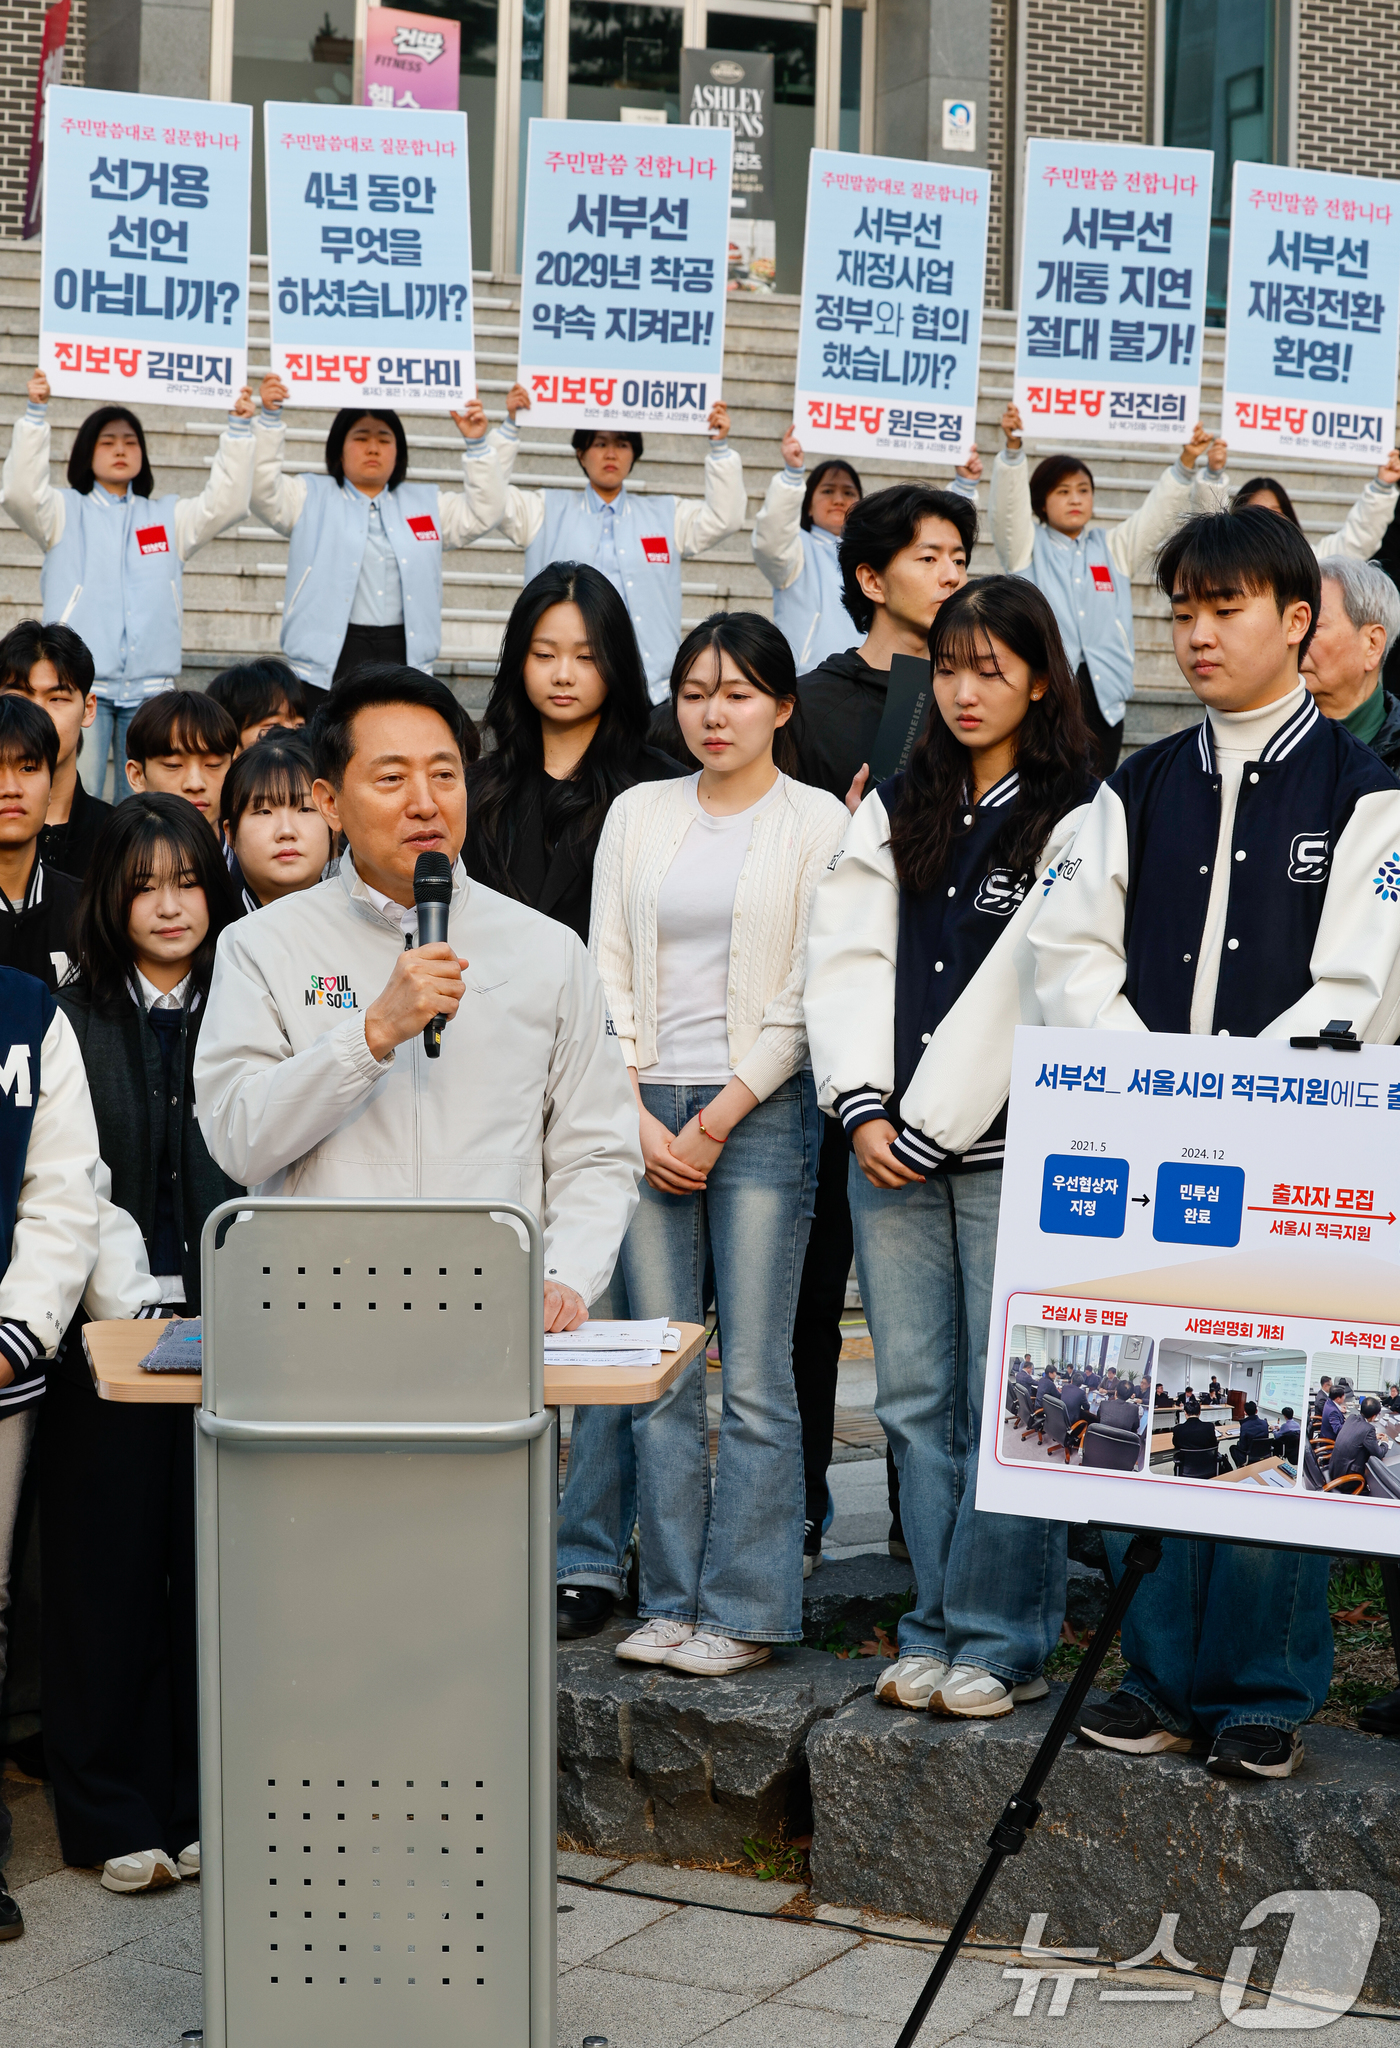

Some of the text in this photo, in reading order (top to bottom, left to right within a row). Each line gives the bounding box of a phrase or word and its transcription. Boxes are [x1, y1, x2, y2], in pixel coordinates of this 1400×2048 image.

[375, 54, 422, 72] FITNESS
[691, 84, 764, 112] ASHLEY
[61, 118, 240, 151] 주민말씀대로 질문합니다
[690, 109, 764, 138] QUEENS
[281, 134, 456, 157] 주민말씀대로 질문합니다
[90, 157, 209, 209] 선거용
[546, 152, 627, 175] 주민말씀
[637, 155, 716, 180] 전합니다
[1043, 167, 1198, 196] 주민말씀 전합니다
[305, 172, 436, 214] 4년 동안
[822, 172, 978, 205] 주민말씀대로 질문합니다
[1249, 190, 1392, 225] 주민말씀 전합니다
[568, 194, 688, 241] 서부선
[854, 207, 942, 250] 서부선
[1063, 207, 1172, 254] 서부선
[109, 215, 188, 264] 선언
[321, 226, 422, 266] 무엇을
[1268, 230, 1369, 279] 서부선
[536, 251, 714, 293] 2029년 착공
[837, 250, 953, 296] 재정사업
[1036, 261, 1192, 310] 개통 지연
[54, 268, 240, 325] 아닙니까?
[278, 277, 467, 321] 하셨습니까?
[1248, 281, 1385, 334] 재정전환
[533, 304, 714, 345] 약속 지켜라!
[815, 294, 969, 344] 정부와 협의
[1027, 316, 1195, 365] 절대 불가!
[1273, 336, 1353, 383] 환영!
[55, 343, 231, 385] 진보당 김민지
[286, 354, 460, 386] 진보당 안다미
[822, 342, 956, 389] 했습니까?
[532, 375, 706, 410] 진보당 이해지
[1028, 387, 1185, 421] 진보당 전진희
[808, 401, 962, 441] 진보당 원은정
[1236, 402, 1382, 442] 진보당 이민지
[899, 692, 926, 766] SENNHEISER
[1128, 1069, 1224, 1099] 서울시의
[1232, 1075, 1378, 1107] 적극지원에도
[1052, 1175, 1118, 1195] 우선협상자
[1180, 1184, 1219, 1202] 민투심
[1273, 1184, 1374, 1211] 출자자 모집
[1070, 1200, 1096, 1216] 지정
[1184, 1208, 1211, 1224] 완료
[1270, 1220, 1370, 1241] 서울시 적극지원
[1042, 1305, 1128, 1326] 건설사 등 면담
[1185, 1318, 1284, 1340] 사업설명회 개최
[1330, 1330, 1386, 1350] 지속적인
